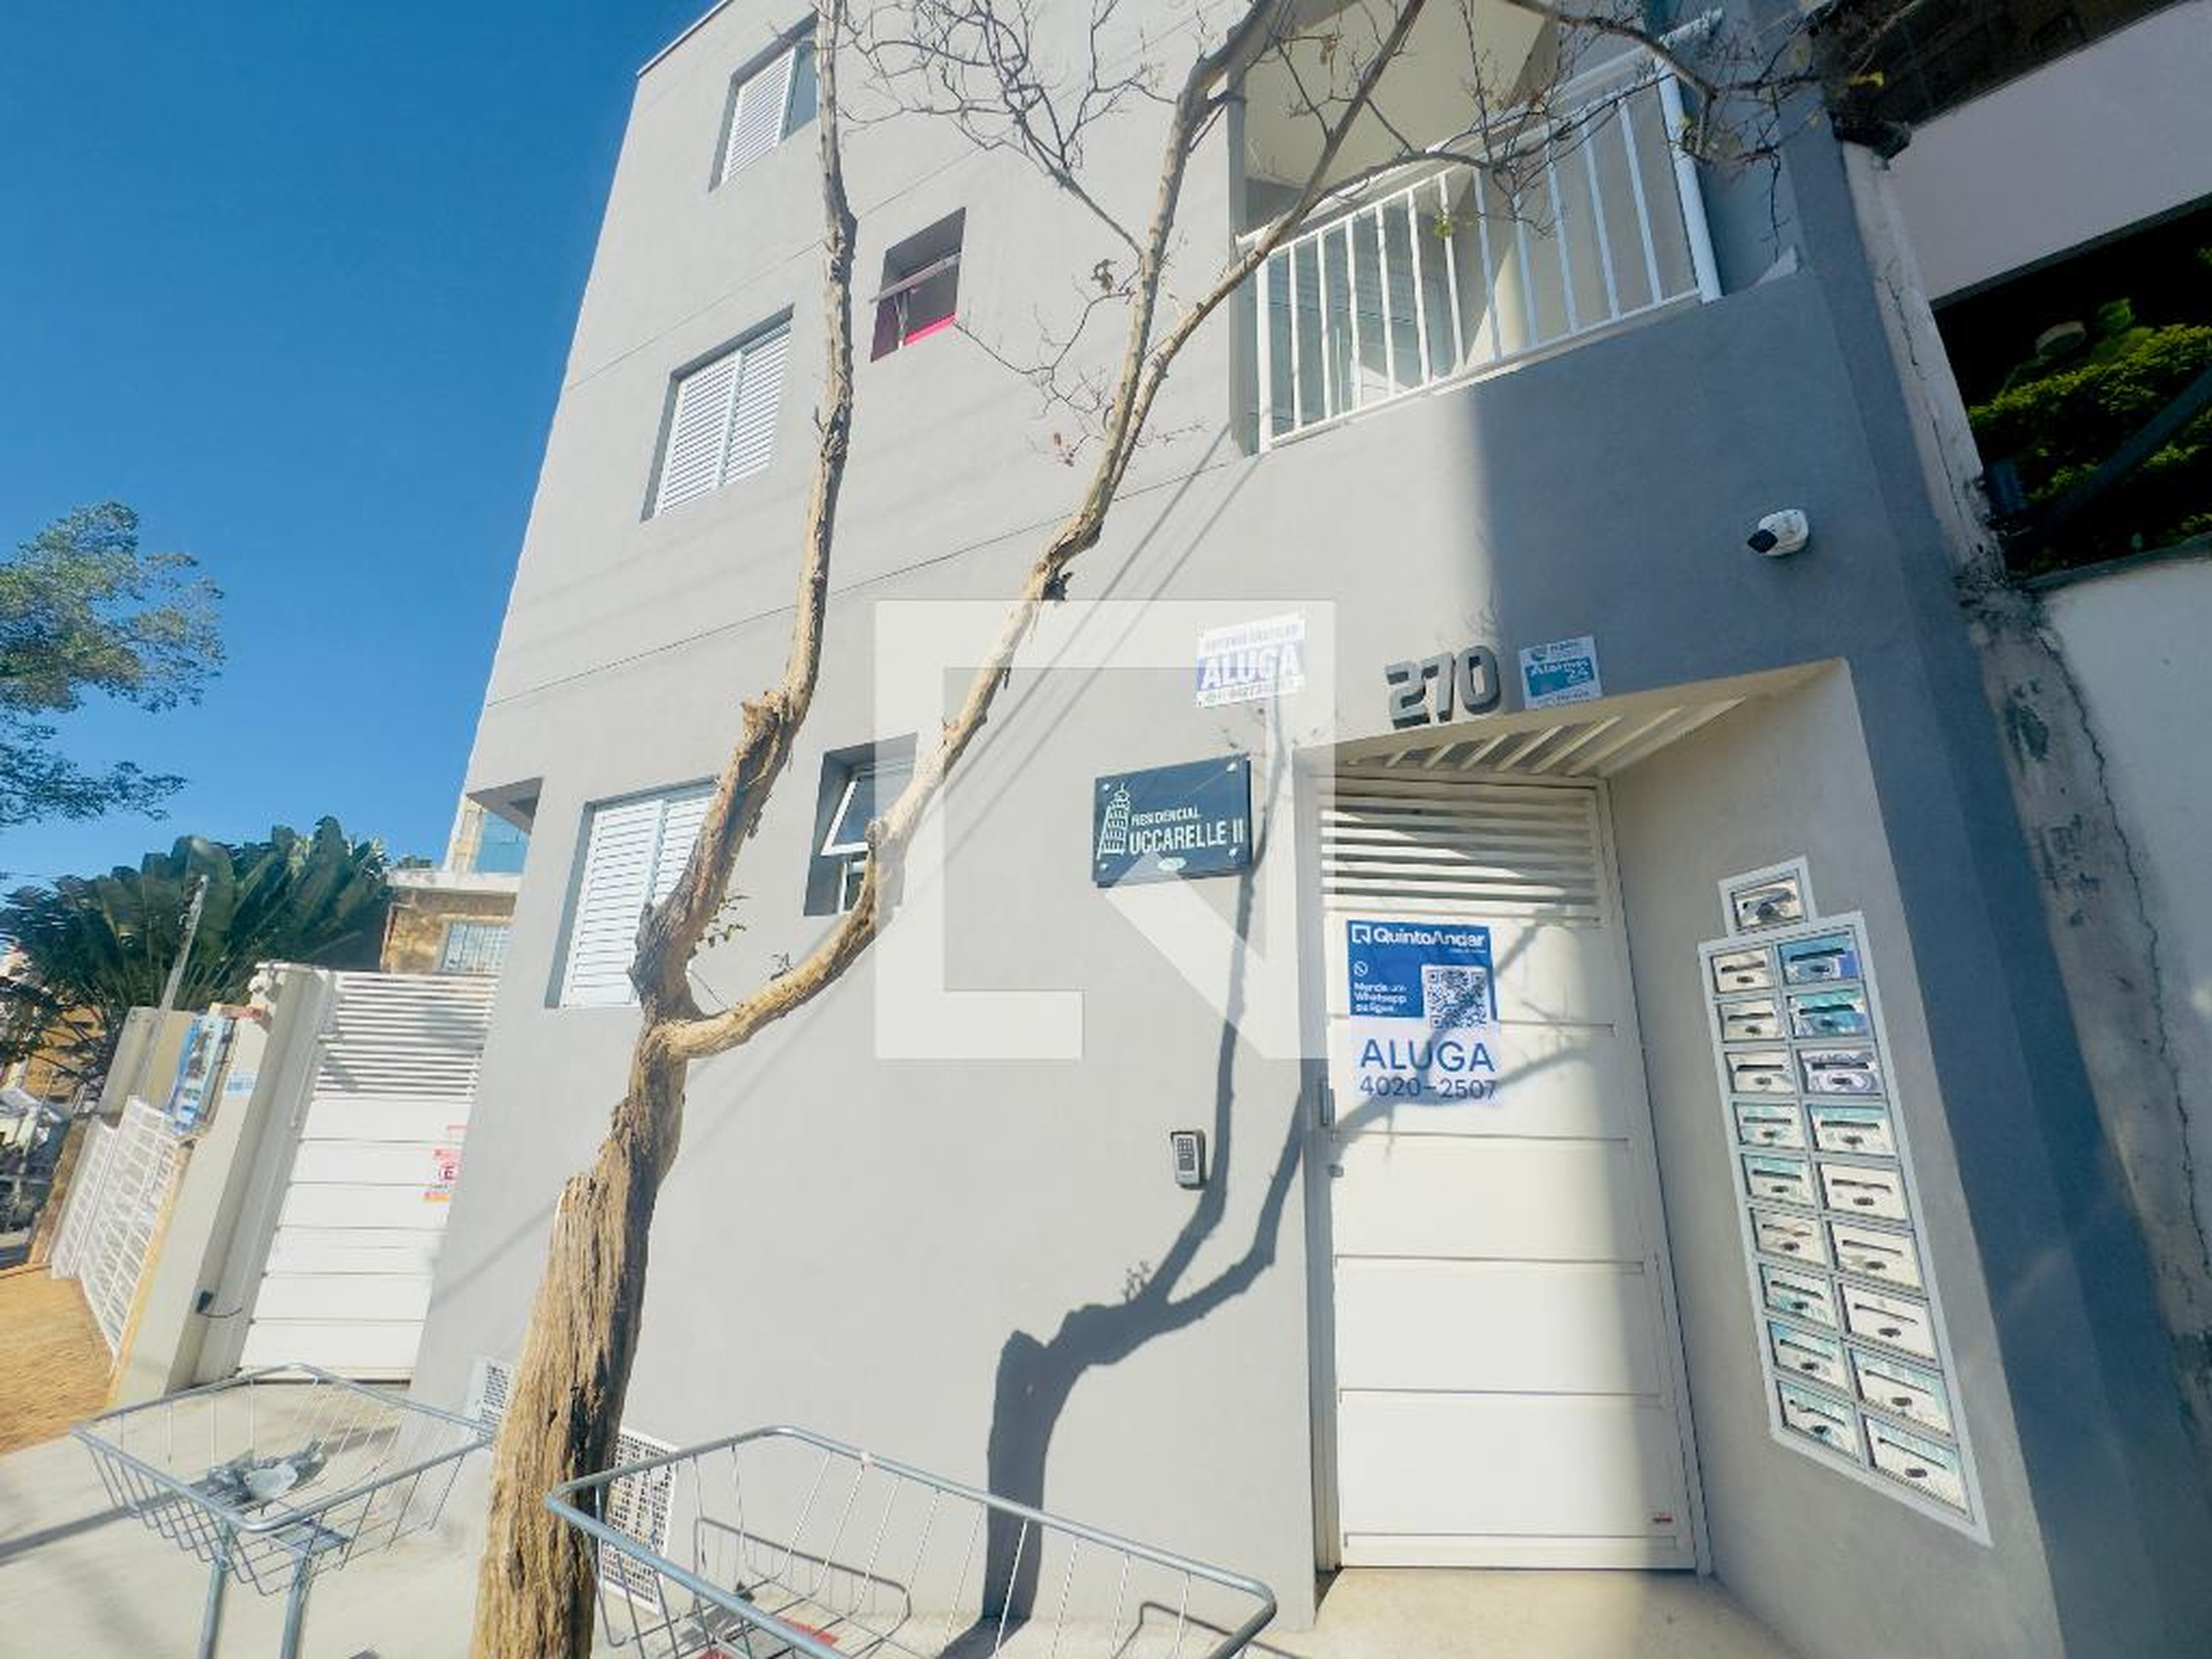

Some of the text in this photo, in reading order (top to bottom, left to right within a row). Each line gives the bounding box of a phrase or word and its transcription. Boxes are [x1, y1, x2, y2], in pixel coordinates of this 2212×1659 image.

[1200, 642, 1301, 691] ALUGA
[1385, 645, 1501, 728] 270
[1131, 805, 1201, 827] RESIDENCIAL
[1233, 818, 1244, 843] II
[1373, 927, 1485, 947] QuintoAndar
[1360, 1038, 1495, 1072] ALUGA
[1360, 1075, 1497, 1099] 4020-2507
